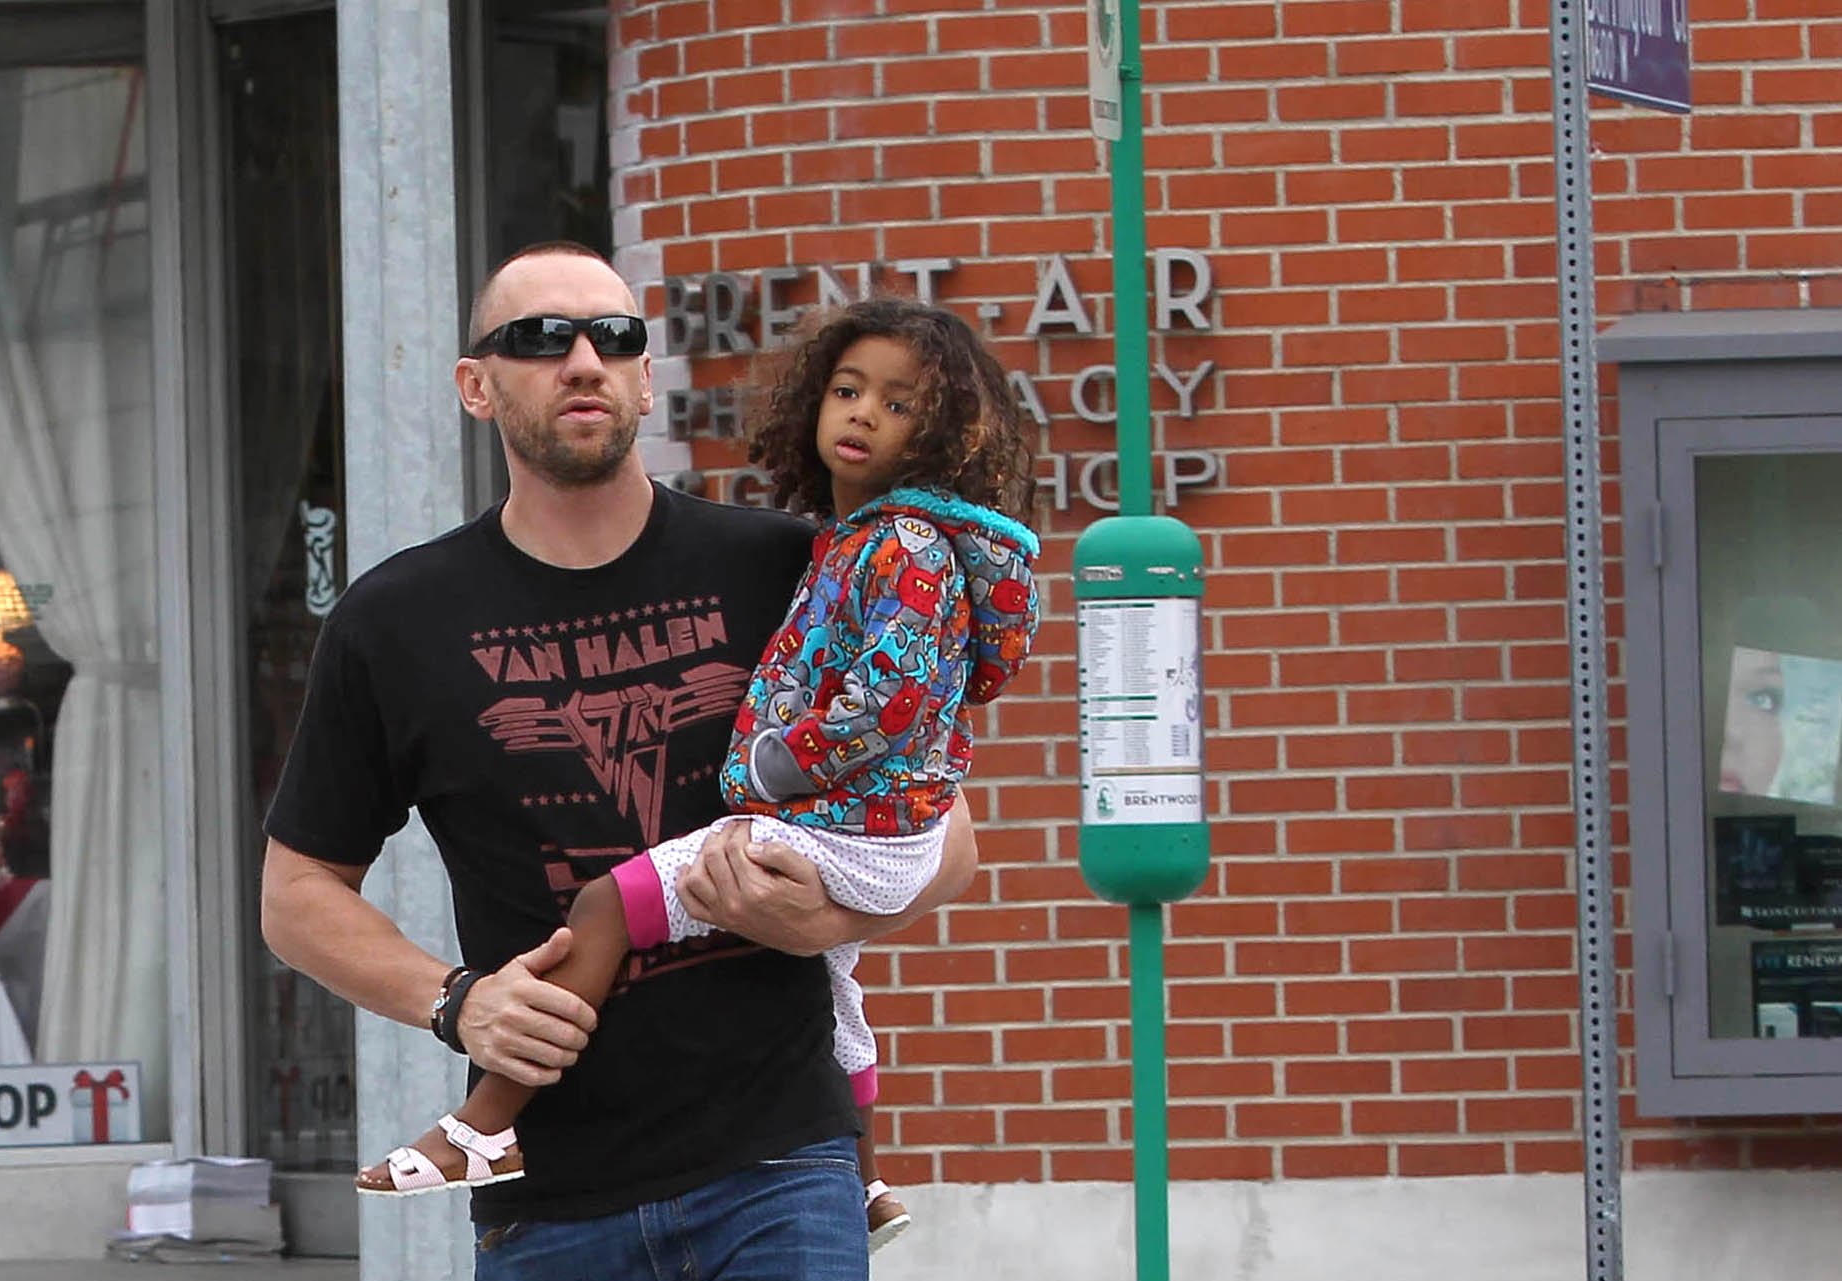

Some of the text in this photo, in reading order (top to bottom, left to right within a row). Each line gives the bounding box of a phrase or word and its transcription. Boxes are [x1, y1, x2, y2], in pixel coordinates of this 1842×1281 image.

[664, 247, 1212, 356] BRENT-AR
[667, 361, 1215, 441] PHACY
[1035, 450, 1220, 511] HOP
[470, 610, 729, 683] VAN HALEN
[1124, 794, 1199, 806] BRENTWOOD
